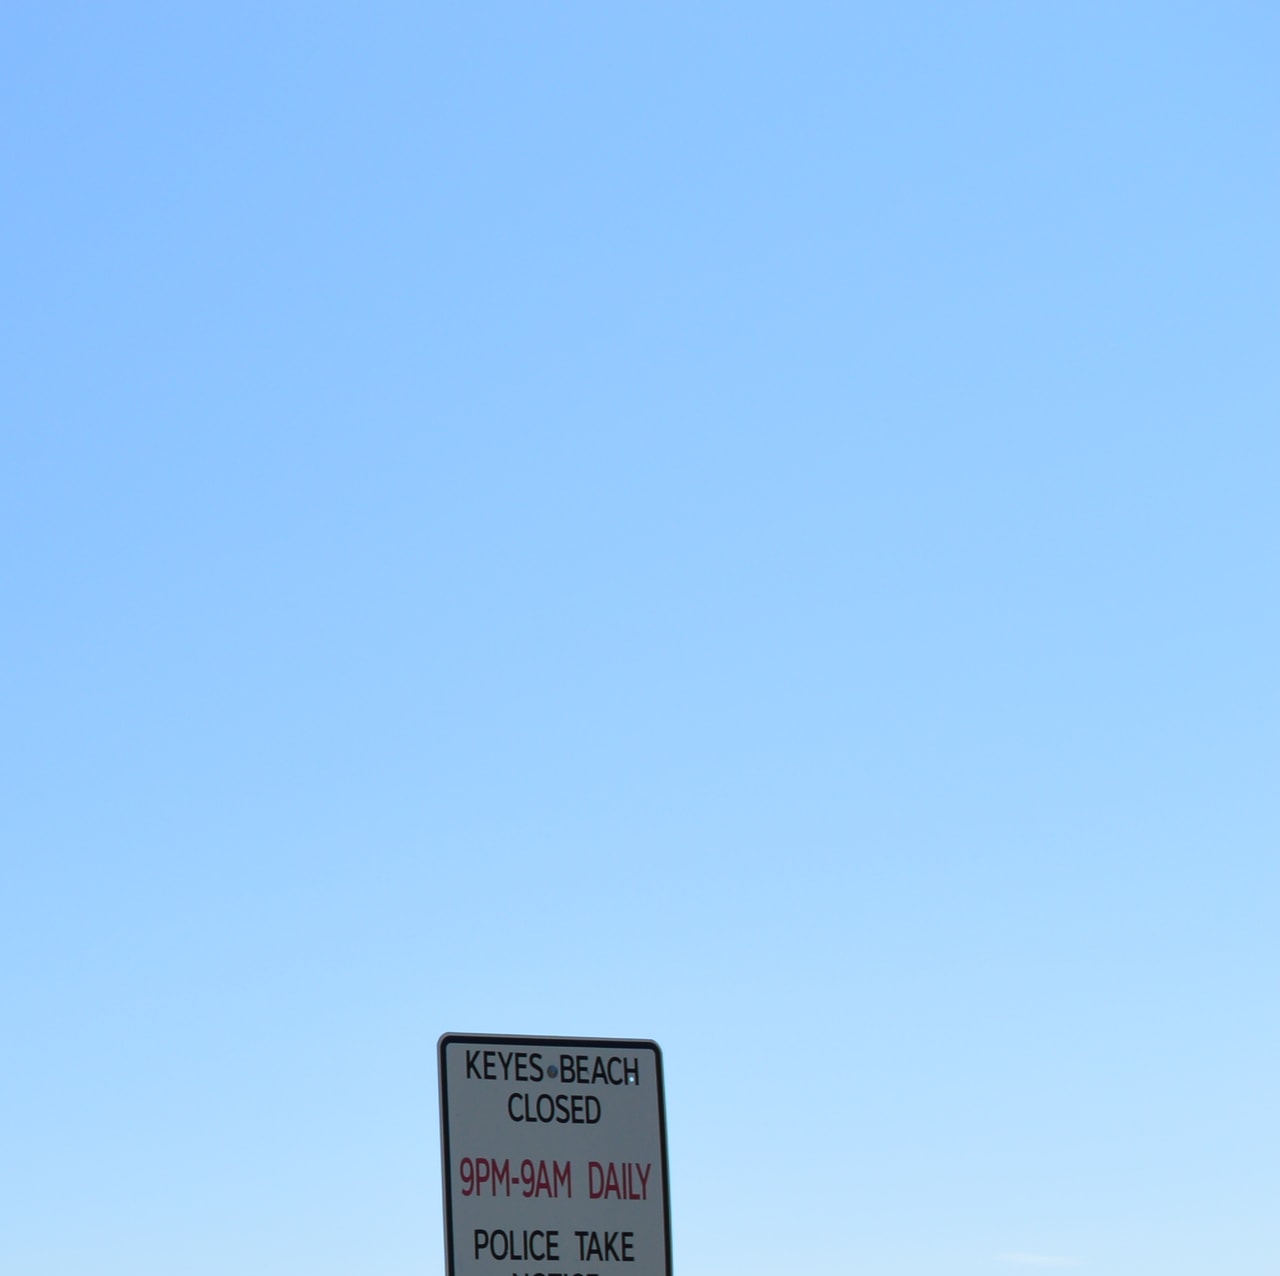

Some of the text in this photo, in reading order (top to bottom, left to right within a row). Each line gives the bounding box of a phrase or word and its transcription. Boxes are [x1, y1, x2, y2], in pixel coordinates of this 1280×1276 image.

[465, 1050, 640, 1086] KEYES BEACH
[507, 1092, 602, 1124] CLOSED
[459, 1157, 651, 1200] 9PM-9AM DAILY
[474, 1229, 635, 1262] POLICE TAKE
